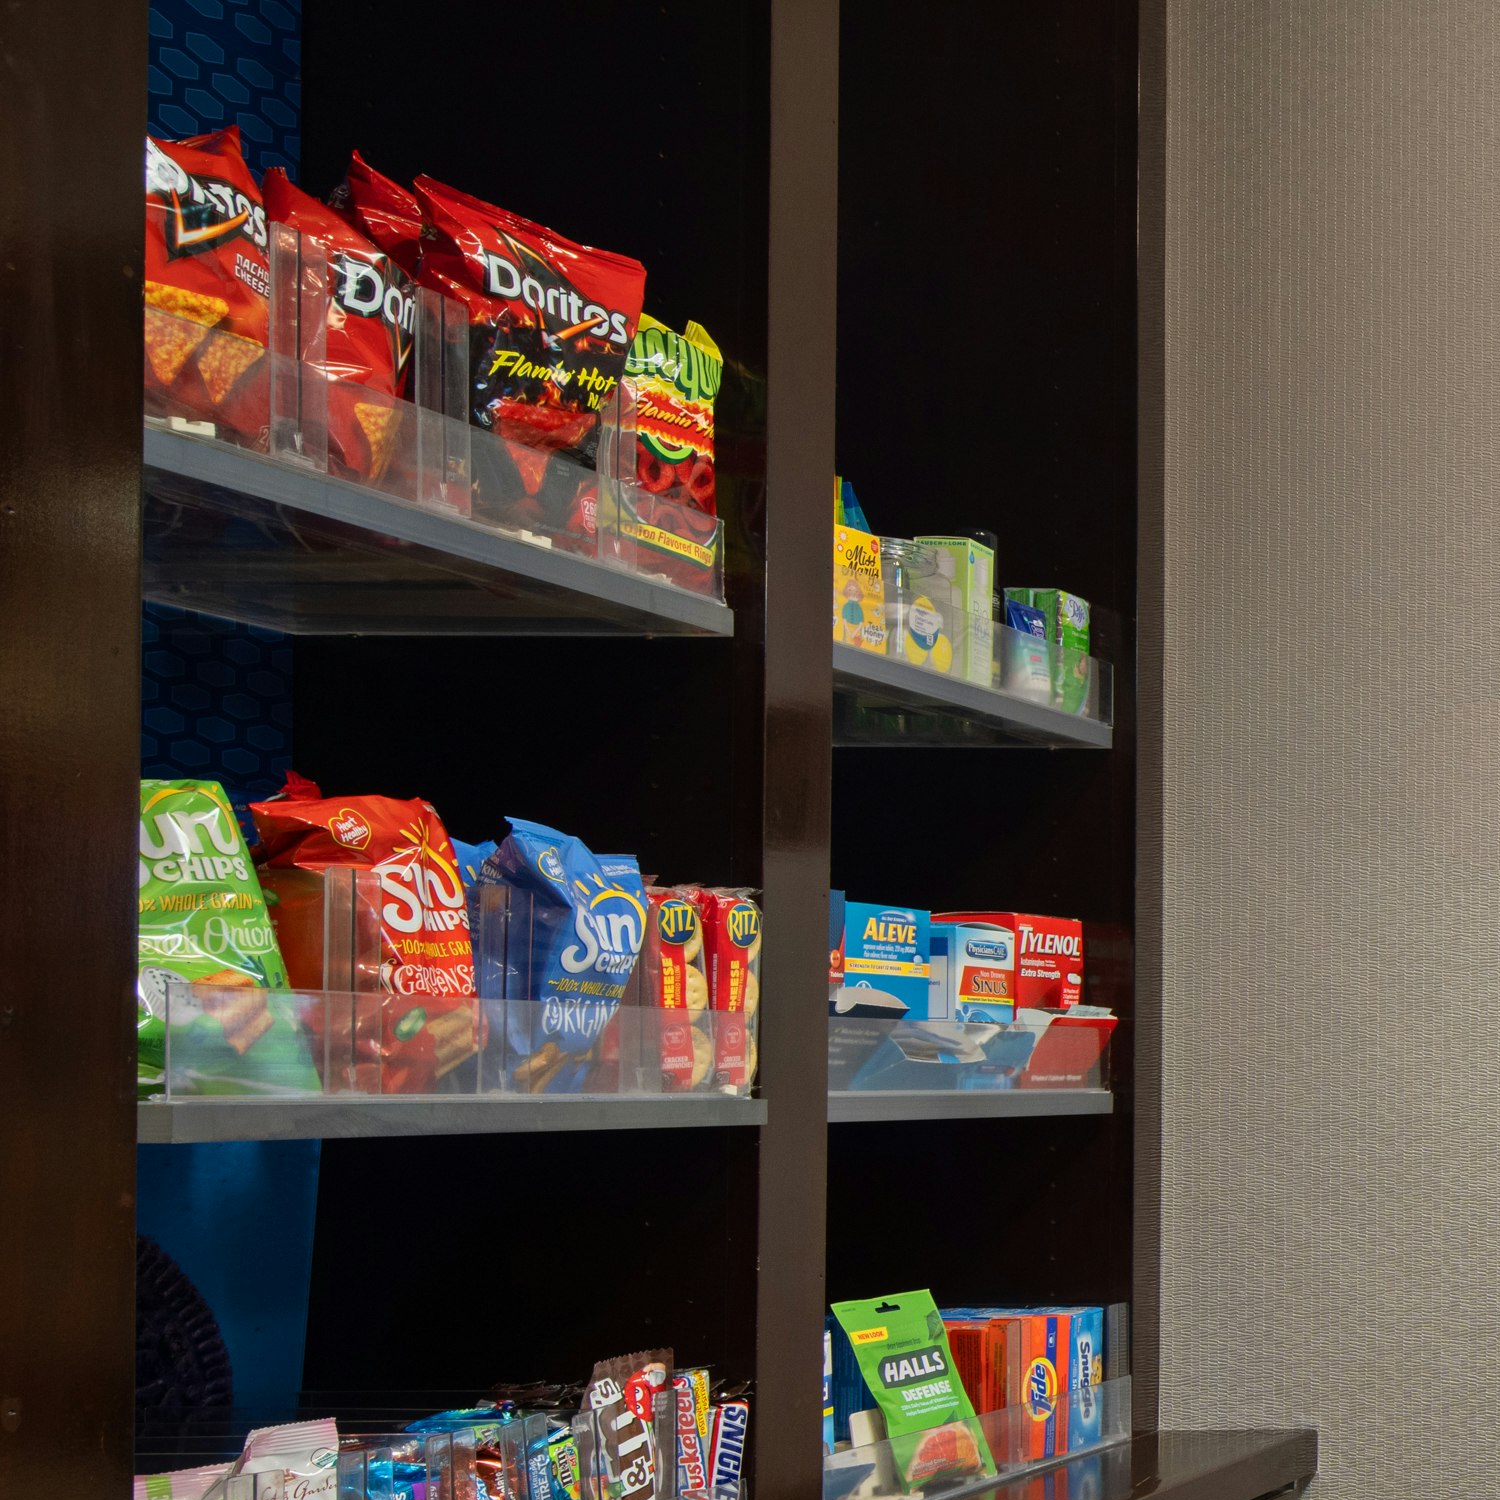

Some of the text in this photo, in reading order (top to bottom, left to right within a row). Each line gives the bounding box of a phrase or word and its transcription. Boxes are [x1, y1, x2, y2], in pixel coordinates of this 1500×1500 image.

[235, 267, 270, 298] CHEESE
[344, 260, 417, 332] Dori
[488, 255, 628, 344] Doritos
[577, 367, 618, 393] Hot
[657, 532, 712, 565] Flavored Rings
[846, 545, 876, 566] Miss
[863, 626, 884, 640] Honey
[141, 808, 240, 860] un
[336, 816, 358, 831] Heart
[153, 855, 249, 882] CHIPS
[161, 892, 253, 912] WHOLE GRAIN
[203, 916, 277, 954] Onion
[661, 905, 695, 938] RITZ
[729, 910, 758, 942] RITZ
[862, 917, 917, 945] ALEVE
[561, 905, 640, 973] Sun
[1018, 926, 1081, 956] TYLENOL
[849, 962, 870, 970] STRENGTH
[1021, 968, 1060, 980] Extra Strength
[728, 960, 740, 1013] CHEESE
[972, 975, 1008, 995] SINUS
[542, 996, 620, 1038] ORIGIN
[857, 1330, 885, 1341] NEW LOOK
[884, 1351, 945, 1383] HALLS
[1080, 1341, 1093, 1419] Snuggle
[901, 1380, 952, 1402] DEFENSE
[1030, 1362, 1052, 1416] Tide
